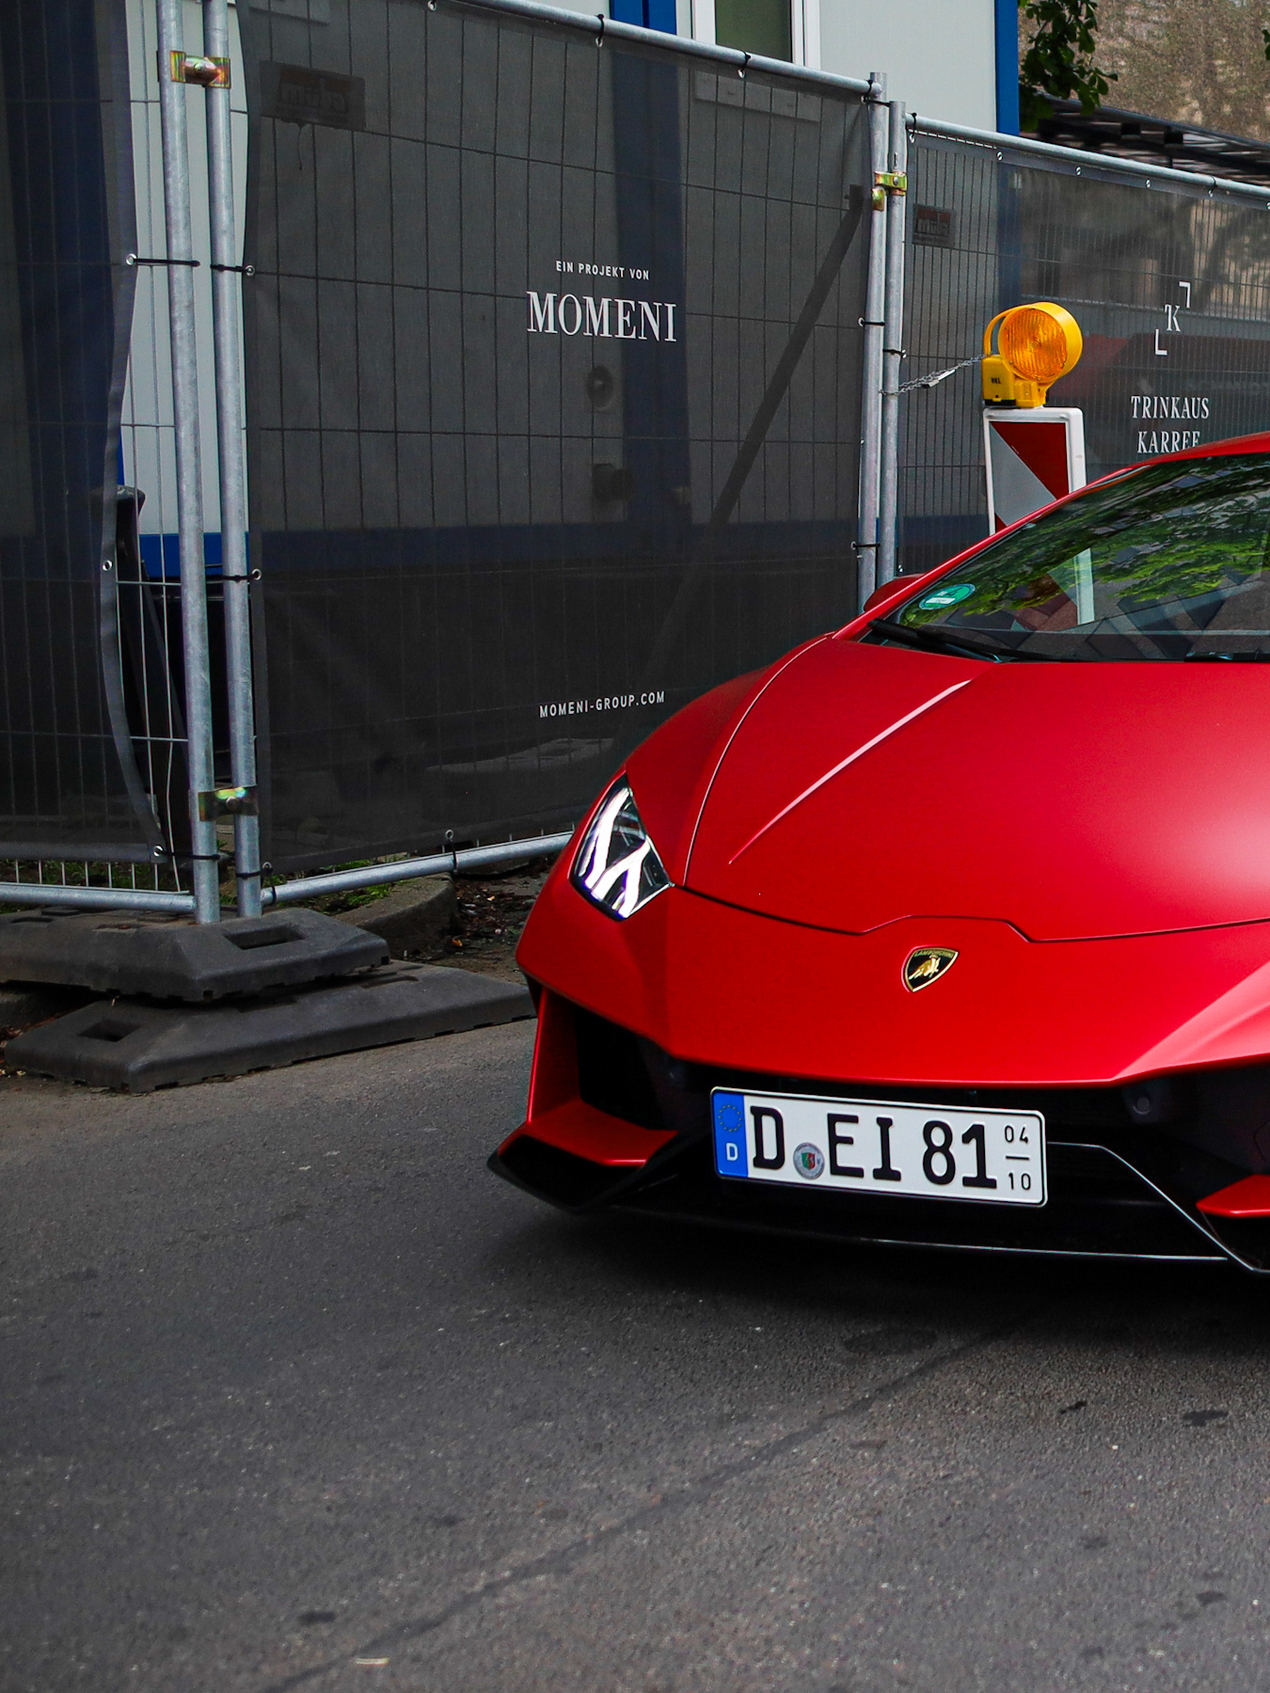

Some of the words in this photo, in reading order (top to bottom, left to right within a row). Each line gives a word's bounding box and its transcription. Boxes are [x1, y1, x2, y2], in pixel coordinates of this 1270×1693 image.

[555, 260, 574, 273] EIN
[578, 262, 625, 278] PROJEKT
[630, 268, 650, 280] VON
[526, 291, 677, 342] MOMENI
[1130, 395, 1210, 419] TRINKAUS
[539, 691, 665, 718] MOMENI-GROUP.COM
[1004, 1125, 1029, 1144] 04
[726, 1142, 739, 1162] D
[750, 1106, 786, 1170] D
[827, 1112, 901, 1181] EI
[922, 1120, 997, 1189] 81
[1008, 1171, 1031, 1190] 10
